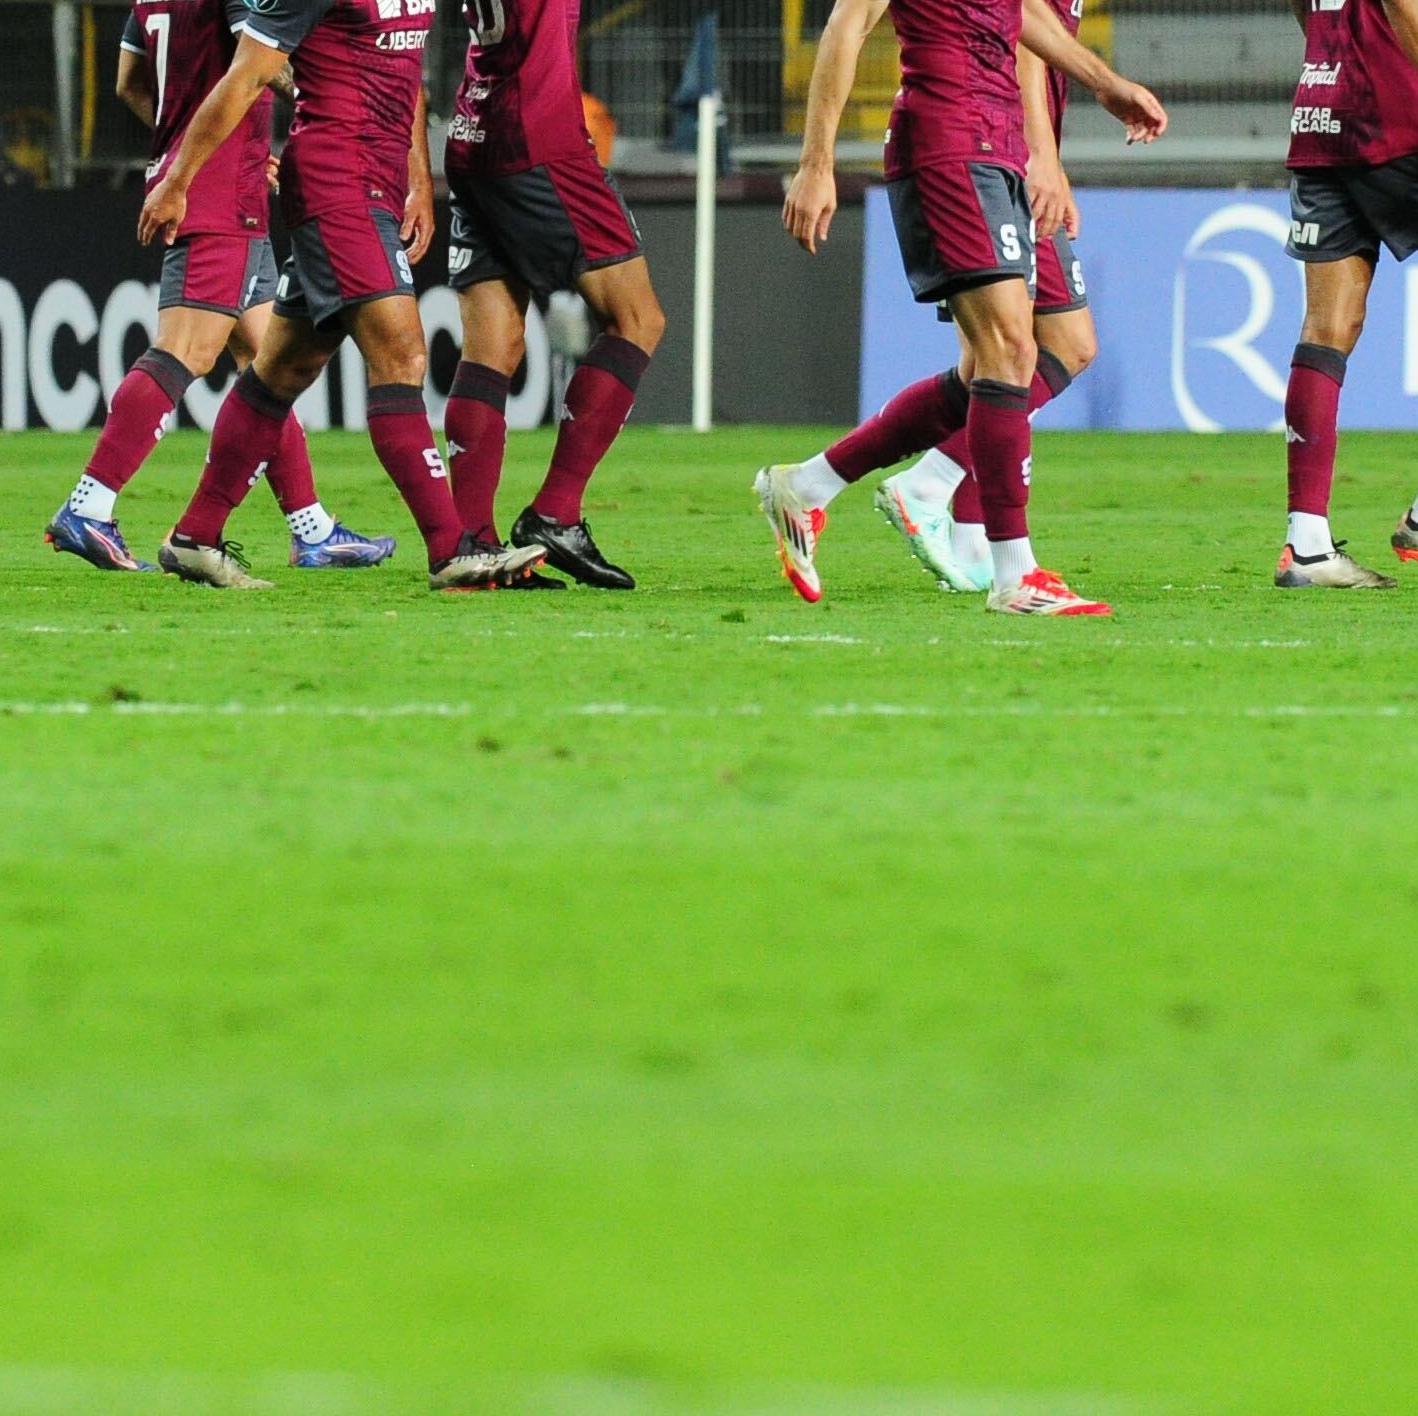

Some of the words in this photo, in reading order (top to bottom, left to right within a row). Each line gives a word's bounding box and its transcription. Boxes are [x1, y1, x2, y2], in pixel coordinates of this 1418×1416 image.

[145, 13, 171, 125] 7
[1294, 106, 1332, 121] STAR
[1299, 120, 1341, 134] CARS
[999, 223, 1022, 261] S
[423, 447, 449, 479] S
